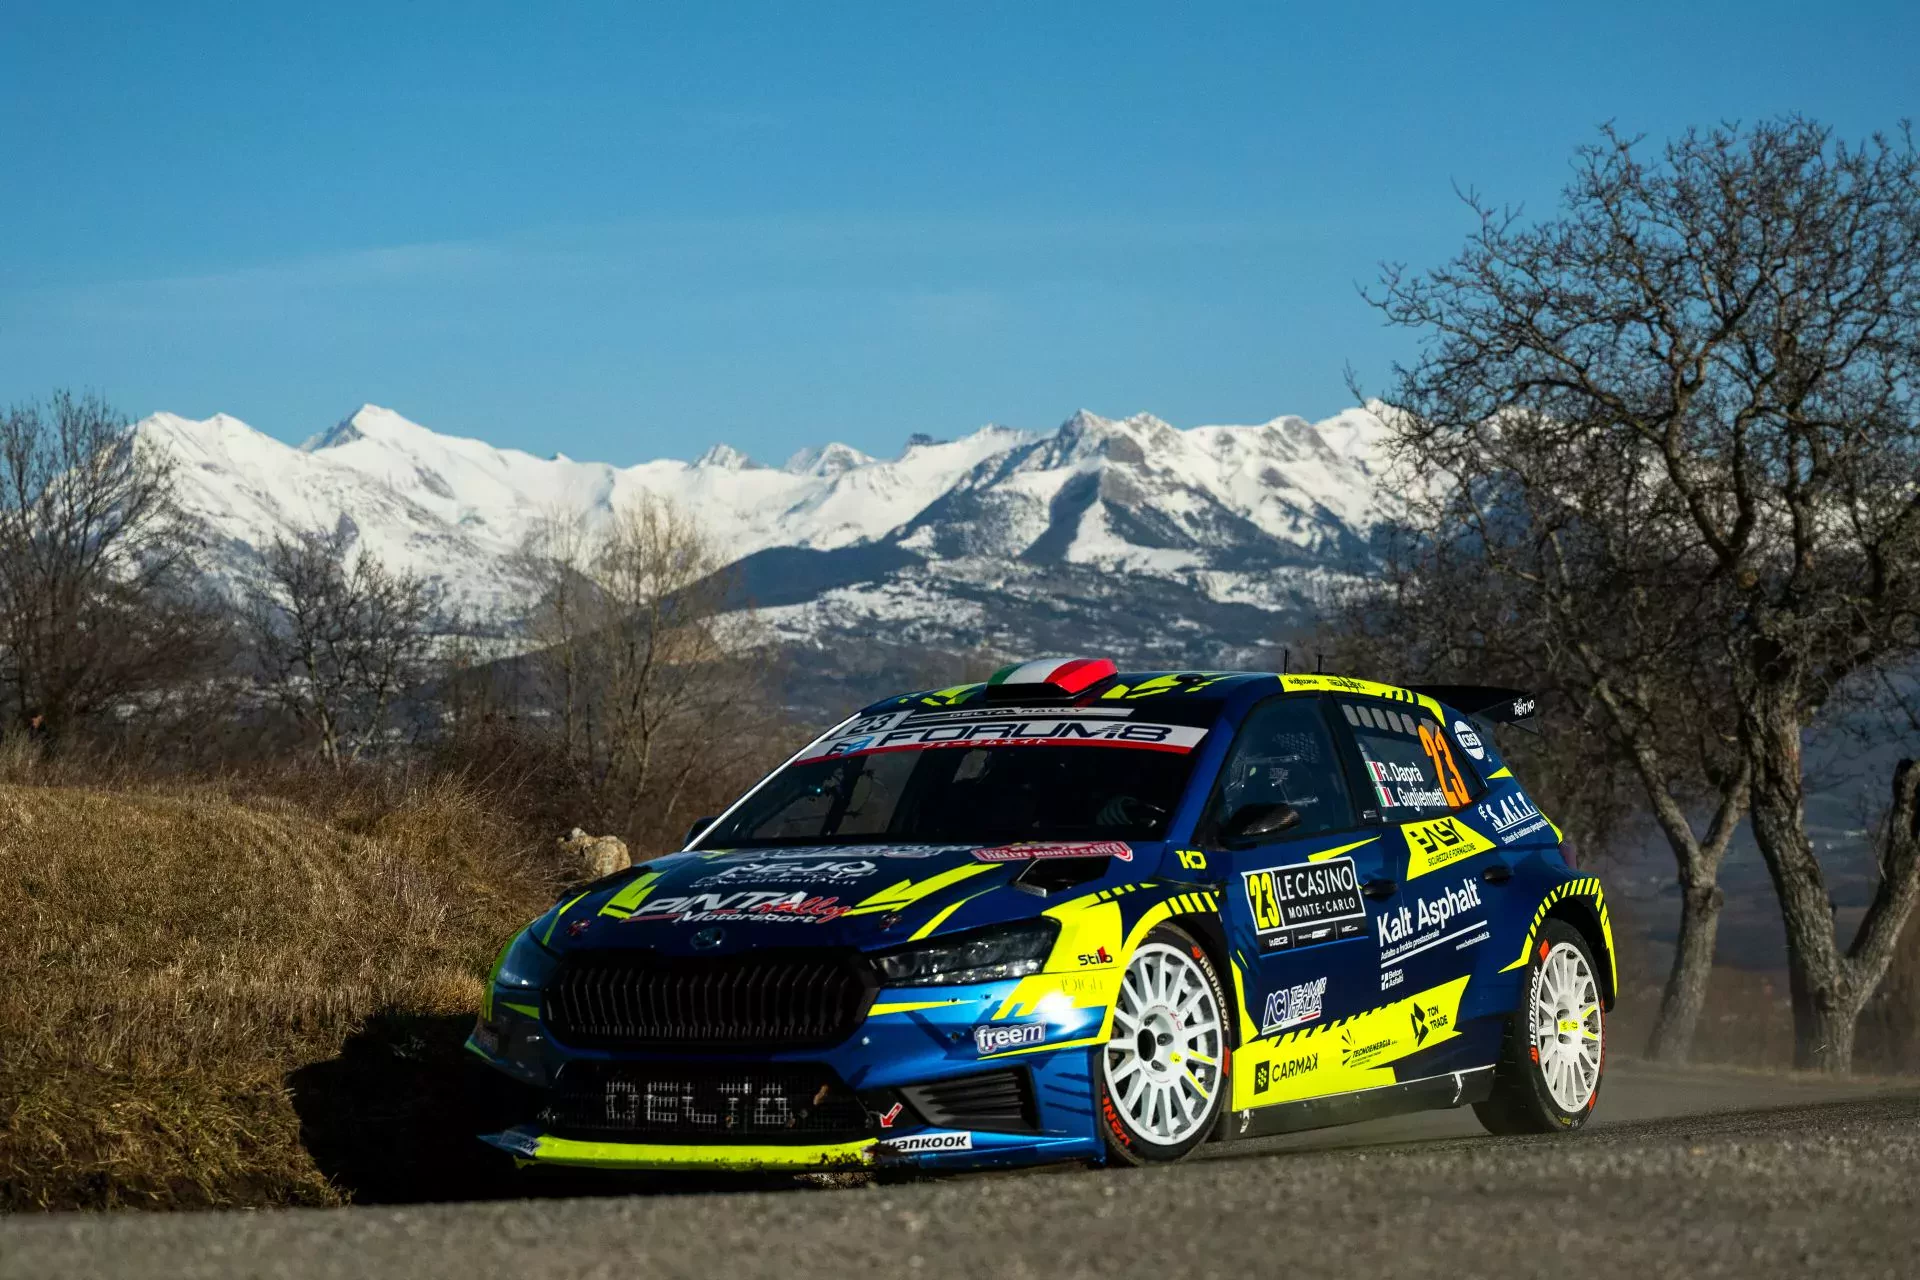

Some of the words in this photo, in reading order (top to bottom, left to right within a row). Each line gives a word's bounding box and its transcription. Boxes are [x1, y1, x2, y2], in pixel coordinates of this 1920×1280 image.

[846, 713, 897, 736] 23
[950, 709, 1008, 718] DELTA
[876, 722, 1173, 747] FORUM8
[1388, 761, 1424, 787] Daprà
[1418, 724, 1472, 807] 23
[1397, 787, 1448, 812] Guglielmetti
[1277, 874, 1295, 901] LE
[1295, 866, 1354, 898] CASINO
[630, 890, 808, 917] PINTA
[1249, 872, 1280, 930] 23
[1376, 906, 1414, 948] Kalt
[1417, 877, 1482, 930] Asphalt
[673, 910, 817, 923] Motorsport
[1388, 969, 1403, 980] Beton
[1290, 979, 1320, 1004] TEAM
[1263, 989, 1291, 1028] ACI
[1430, 1014, 1448, 1031] TRADE
[978, 1025, 1043, 1048] freem
[1271, 1053, 1319, 1083] CARMAX
[606, 1080, 788, 1126] DELTA
